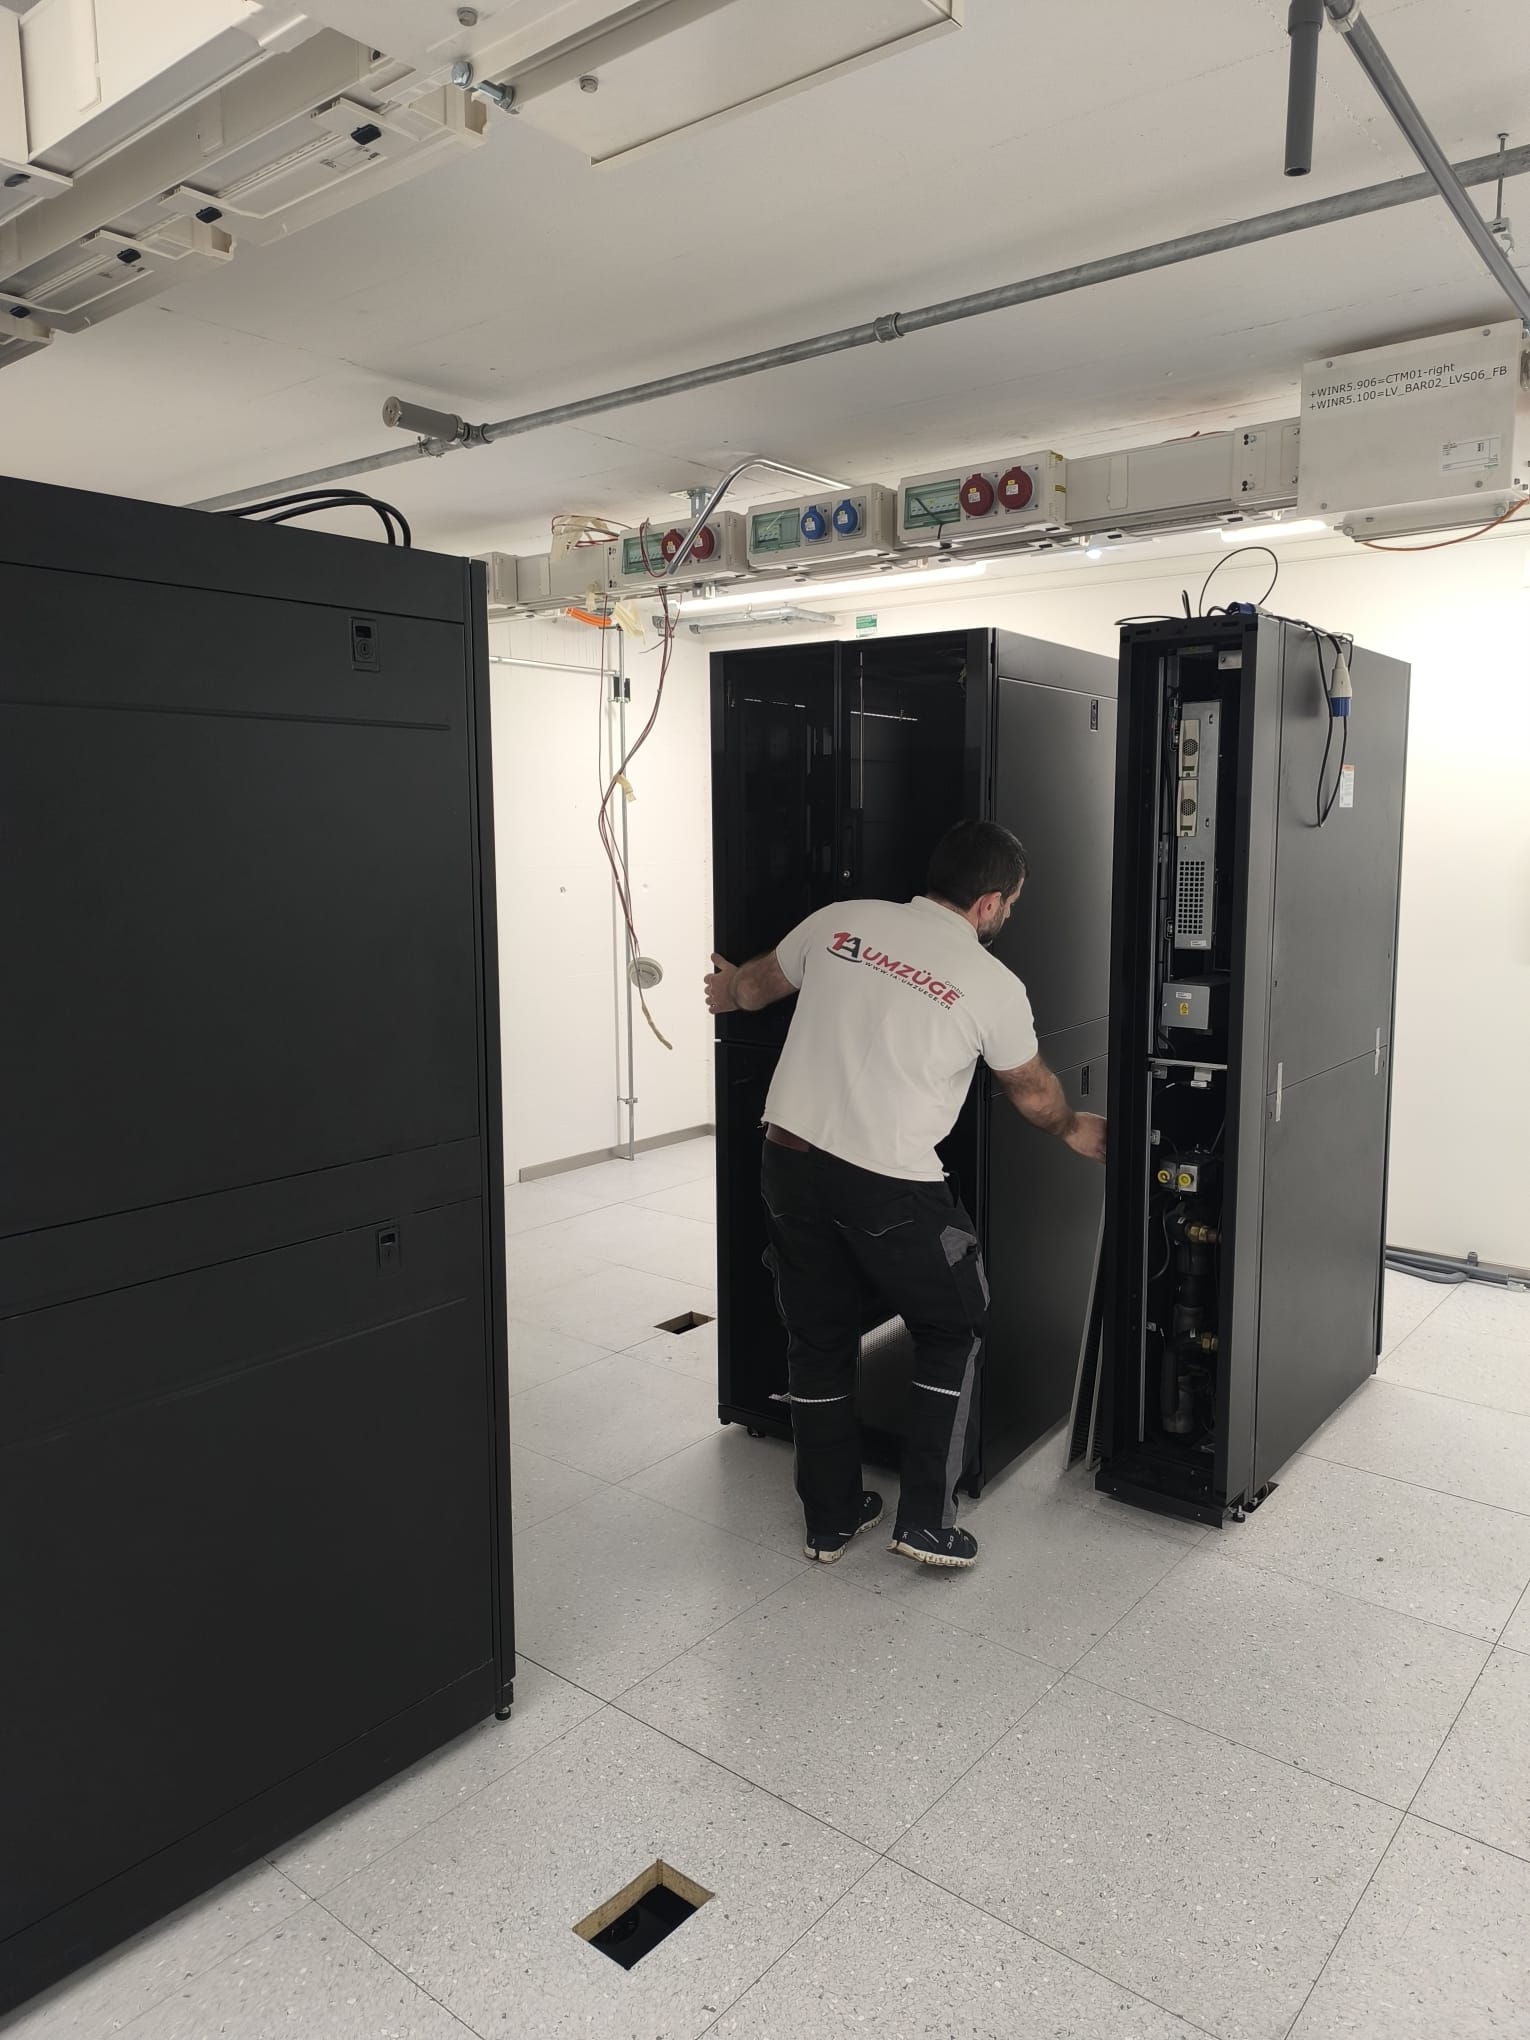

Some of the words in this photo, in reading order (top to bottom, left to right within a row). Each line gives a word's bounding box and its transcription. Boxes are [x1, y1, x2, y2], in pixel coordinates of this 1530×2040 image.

[1310, 364, 1455, 397] +WINR5.906=CTM01-right
[1310, 366, 1507, 410] +WINR5.100=LV_BAR02_LVS06_FB
[862, 946, 960, 1006] UMZÜGE
